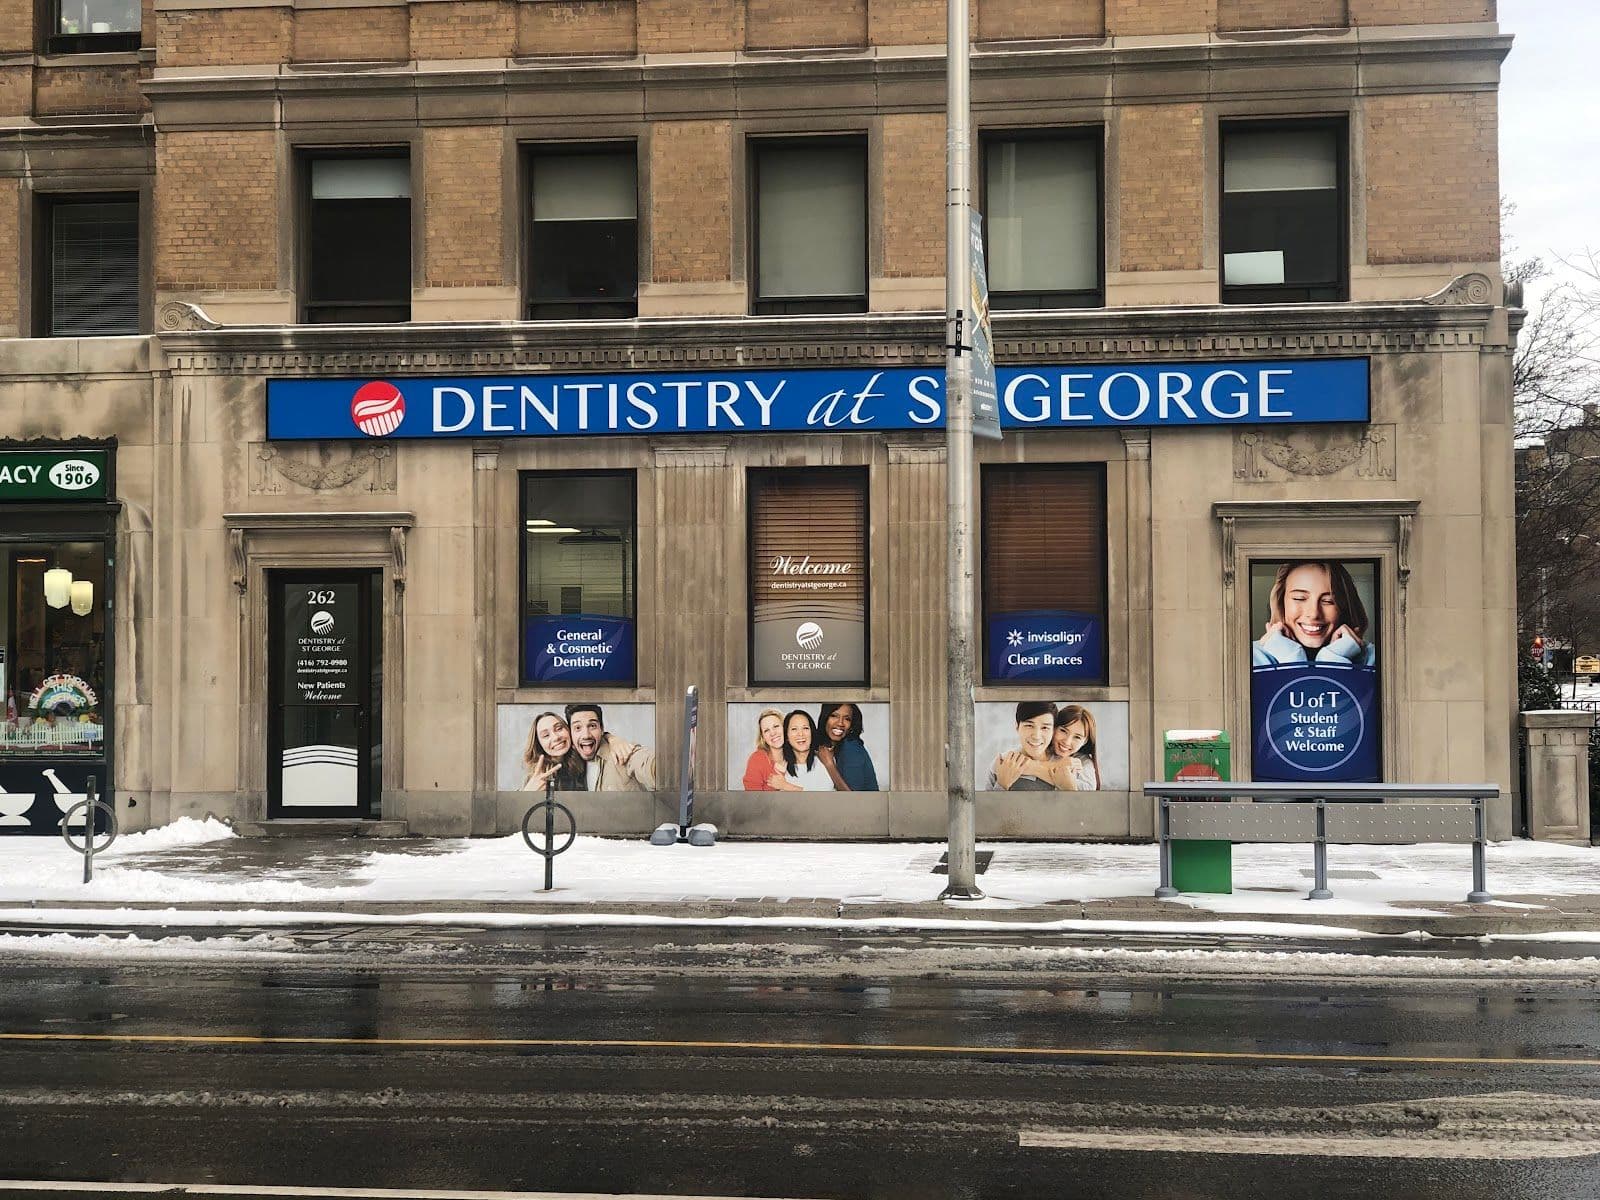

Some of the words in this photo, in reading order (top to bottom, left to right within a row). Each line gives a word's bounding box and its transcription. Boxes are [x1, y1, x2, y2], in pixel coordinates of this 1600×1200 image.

[432, 380, 787, 433] DENTISTRY
[806, 371, 885, 427] at
[907, 375, 950, 424] S
[1003, 368, 1294, 422] GEORGE
[65, 463, 84, 472] Since
[56, 472, 93, 485] 1906
[769, 555, 852, 576] Welcome
[771, 581, 847, 590] dentistryatstgeorge.ca
[307, 590, 336, 605] 262
[556, 628, 602, 641] General
[298, 637, 337, 645] DENTISTRY
[546, 643, 556, 654] &
[559, 642, 613, 654] Cosmetic
[781, 653, 826, 661] DENTISTRY
[827, 652, 838, 661] at
[1007, 653, 1040, 665] Clear
[1043, 653, 1083, 665] Braces
[297, 659, 314, 667] (416)
[553, 656, 606, 670] Dentistry
[786, 662, 796, 670] ST
[797, 662, 832, 670] GEORGE
[316, 681, 346, 689] Patients
[303, 690, 343, 701] Welcome
[1289, 691, 1304, 708] U
[1307, 692, 1325, 708] of
[1326, 691, 1340, 708] T
[1290, 711, 1339, 724] Student
[1293, 726, 1304, 738] &
[1307, 725, 1337, 738] Staff
[1285, 739, 1345, 752] Welcome
